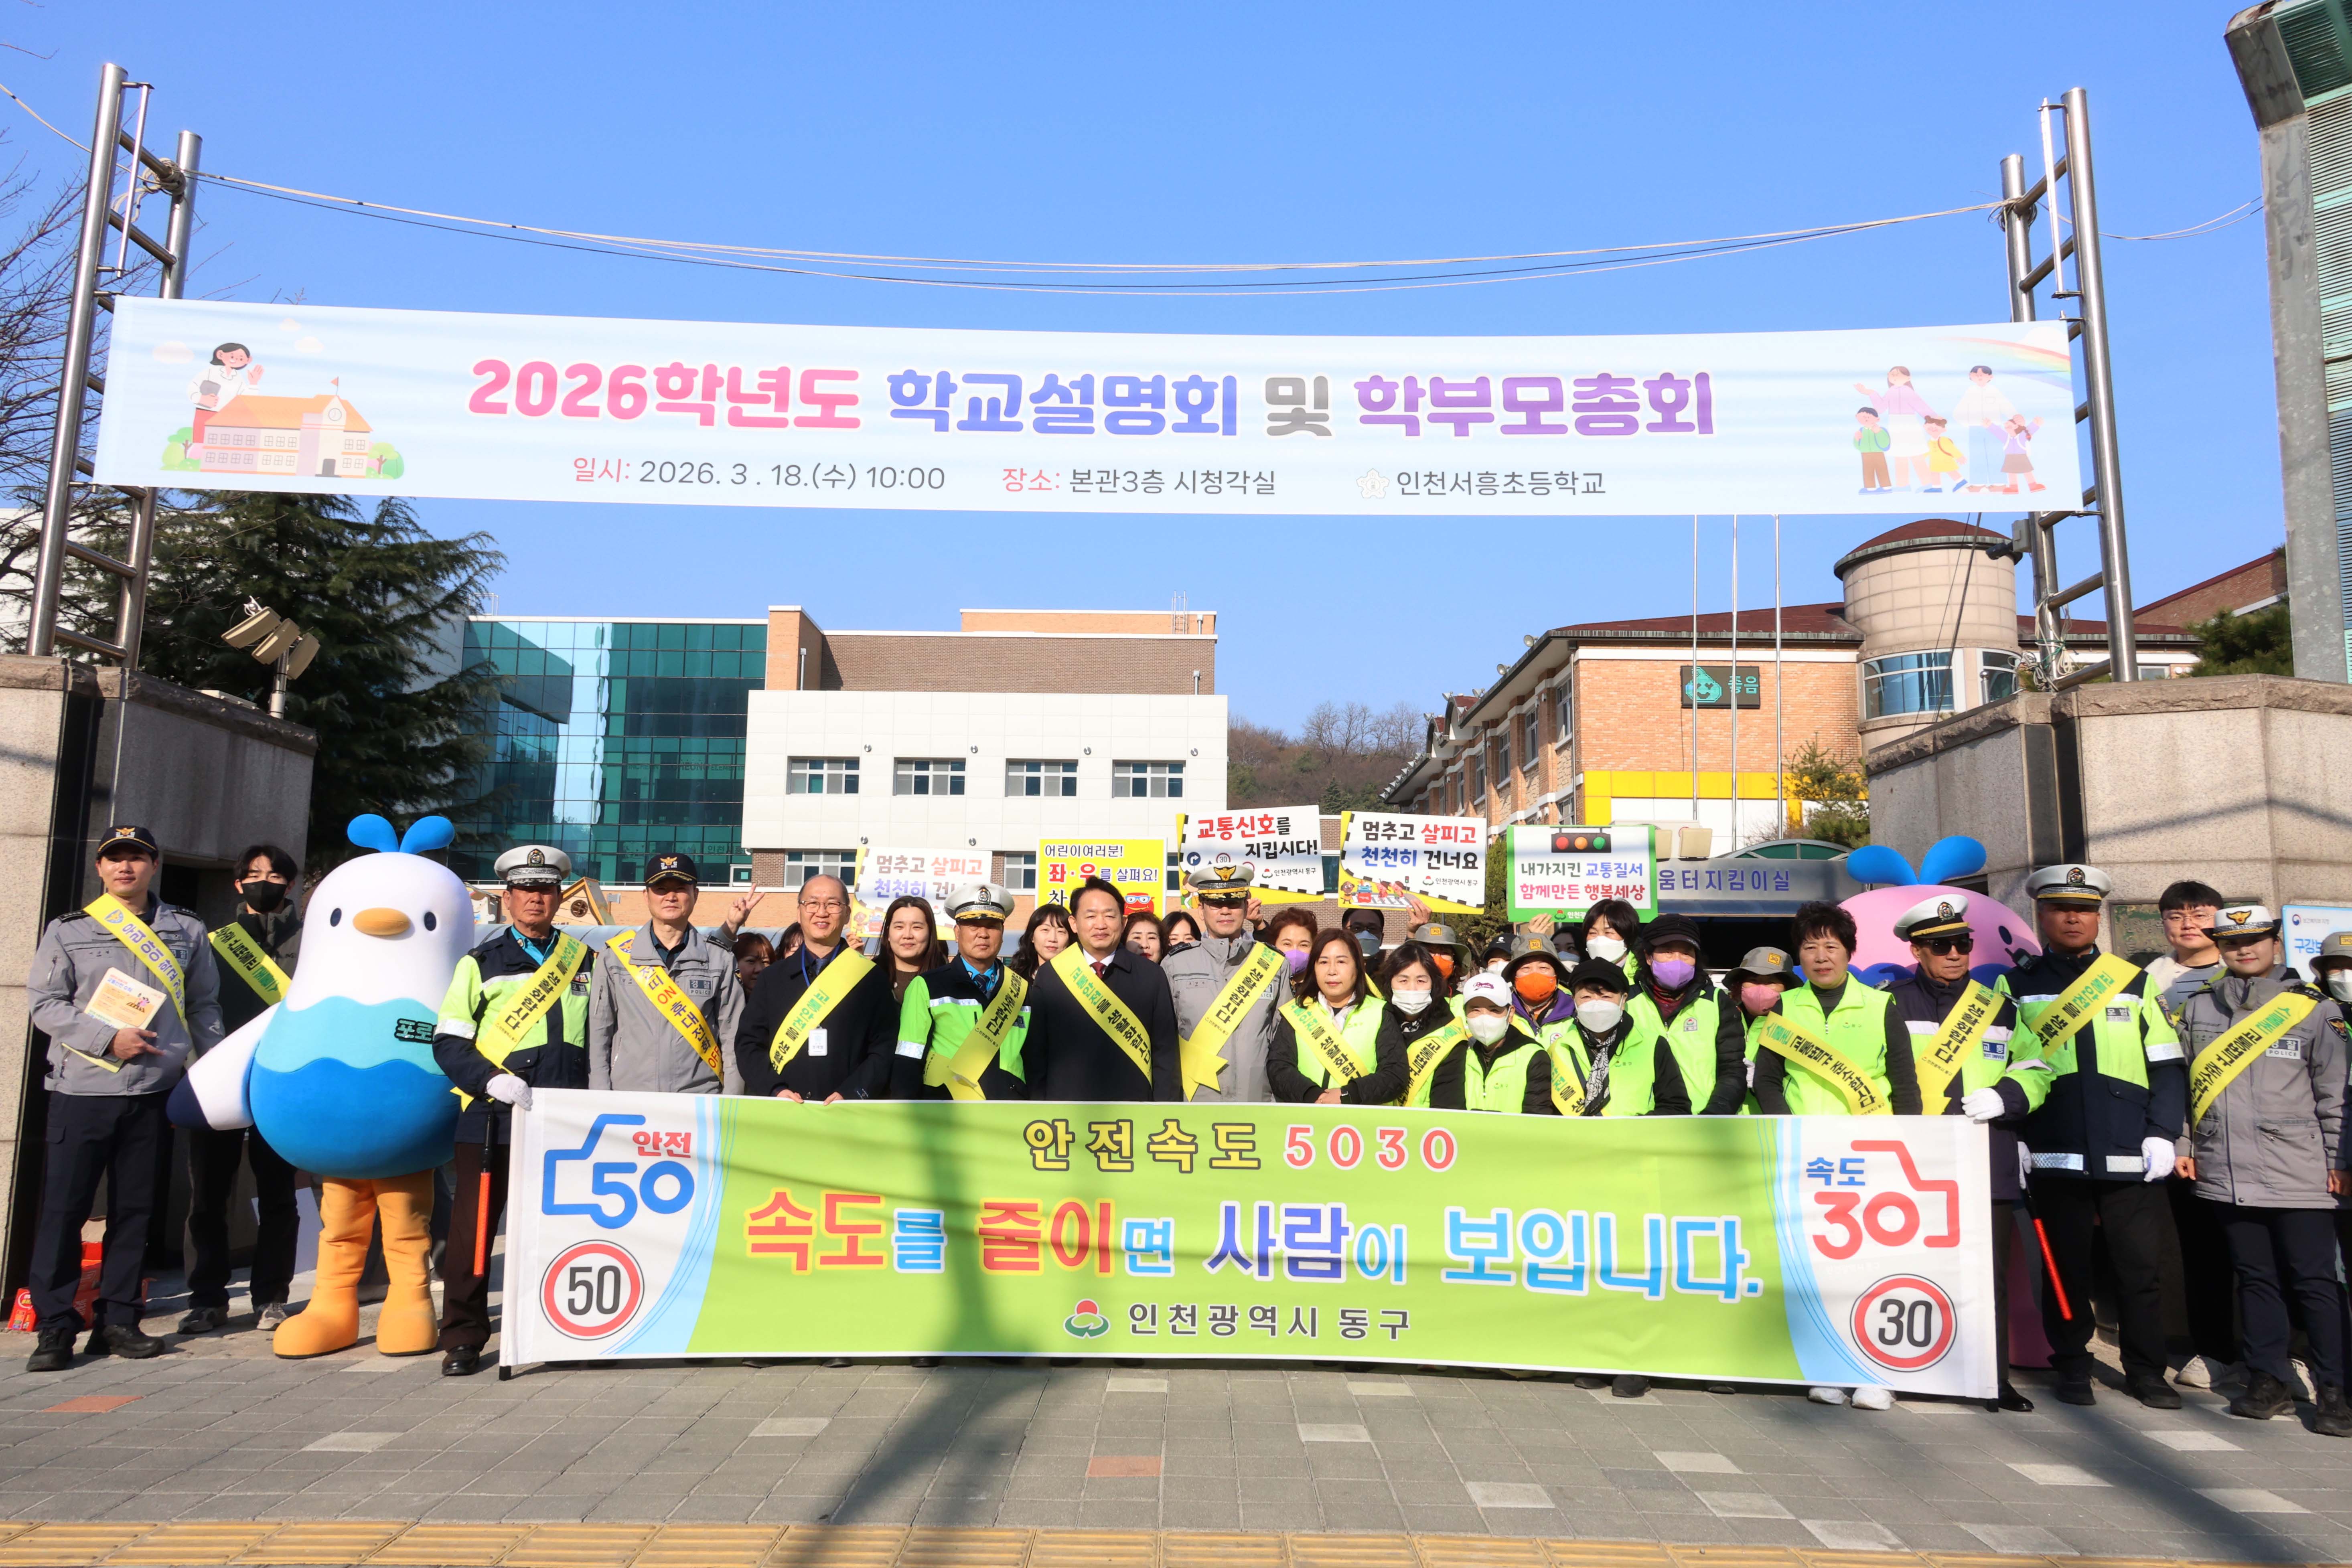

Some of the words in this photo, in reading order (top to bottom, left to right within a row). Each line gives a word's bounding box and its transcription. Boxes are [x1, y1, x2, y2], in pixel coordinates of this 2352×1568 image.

[468, 359, 861, 429] 2026학년도
[886, 369, 1237, 436] 학교설명회
[1265, 375, 1332, 437] 및
[1353, 371, 1714, 437] 학부모총회
[574, 458, 630, 482] 일시:
[639, 460, 720, 484] 2026.
[866, 466, 945, 489] 10:00
[1002, 468, 1060, 492] 장소:
[1069, 468, 1165, 494] 본관3층
[1174, 470, 1275, 494] 시청각실
[1397, 471, 1606, 496] 인천서흥초등학교
[1198, 814, 1291, 841] 교통신호를
[1363, 821, 1415, 841] 멈추고
[1421, 824, 1476, 844] 살피고
[1045, 845, 1123, 857] 어린이여러분!
[1245, 840, 1318, 859] 지킵시다!
[1361, 846, 1417, 868] 천천히
[1423, 850, 1479, 870] 건너요
[876, 855, 925, 874] 멈추고
[931, 857, 983, 876] 살피고
[1117, 869, 1157, 881] 살펴요!
[1521, 862, 1581, 877] 내가지킨
[1586, 862, 1643, 878] 교통질서
[1658, 869, 1790, 891] 움터지킴이실
[874, 878, 927, 898] 천천히
[1520, 883, 1580, 900] 함께만든
[1584, 883, 1645, 901] 행복세상
[1567, 911, 1585, 919] 인천광
[122, 924, 146, 943] 우리
[141, 940, 164, 962] 아이
[158, 959, 178, 981] 학교
[1257, 947, 1276, 971] 안전을
[2294, 938, 2322, 954] 구강보
[690, 980, 711, 989] 경찰
[1215, 968, 1264, 1024] 생활화합시다
[2062, 971, 2115, 1019] 교통안전을
[504, 971, 561, 1030] 생활화합시다
[785, 989, 830, 1041] 교통안전을
[985, 993, 1016, 1037] 준수합시다
[1070, 966, 1112, 1015] 교통안전을
[1107, 1009, 1151, 1065] 생활화합시다
[2107, 1009, 2130, 1017] 모범
[396, 1019, 433, 1041] 포로
[637, 964, 664, 990] 전띠
[657, 986, 677, 1005] ON
[670, 1001, 711, 1053] 휴대전화
[708, 1045, 720, 1068] OFF
[2255, 1007, 2291, 1035] 스쿨존
[1934, 1004, 1985, 1064] 생활화합시다
[1983, 1043, 2004, 1053] 교통
[2216, 1028, 2263, 1067] 교통법규
[1320, 1036, 1362, 1078] 생활화합
[1409, 1039, 1441, 1077] 교통법규
[1790, 1035, 1833, 1066] 교통법규
[1830, 1061, 1876, 1108] 준수합시다
[632, 1130, 691, 1158] 안전
[1024, 1118, 1261, 1173] 안전속도
[1285, 1124, 1457, 1171] 5030
[1805, 1157, 1867, 1187] 속도
[590, 1160, 695, 1230] 50
[1812, 1191, 1920, 1260] 30
[744, 1187, 948, 1275] 속도를
[975, 1197, 1175, 1277] 줄이면
[1202, 1199, 1408, 1285] 사람이
[1441, 1205, 1764, 1303] 보입니다.
[568, 1264, 621, 1317] 50
[1128, 1303, 1319, 1339] 인천광역시
[1338, 1308, 1411, 1340] 동구
[1877, 1298, 1932, 1347] 30
